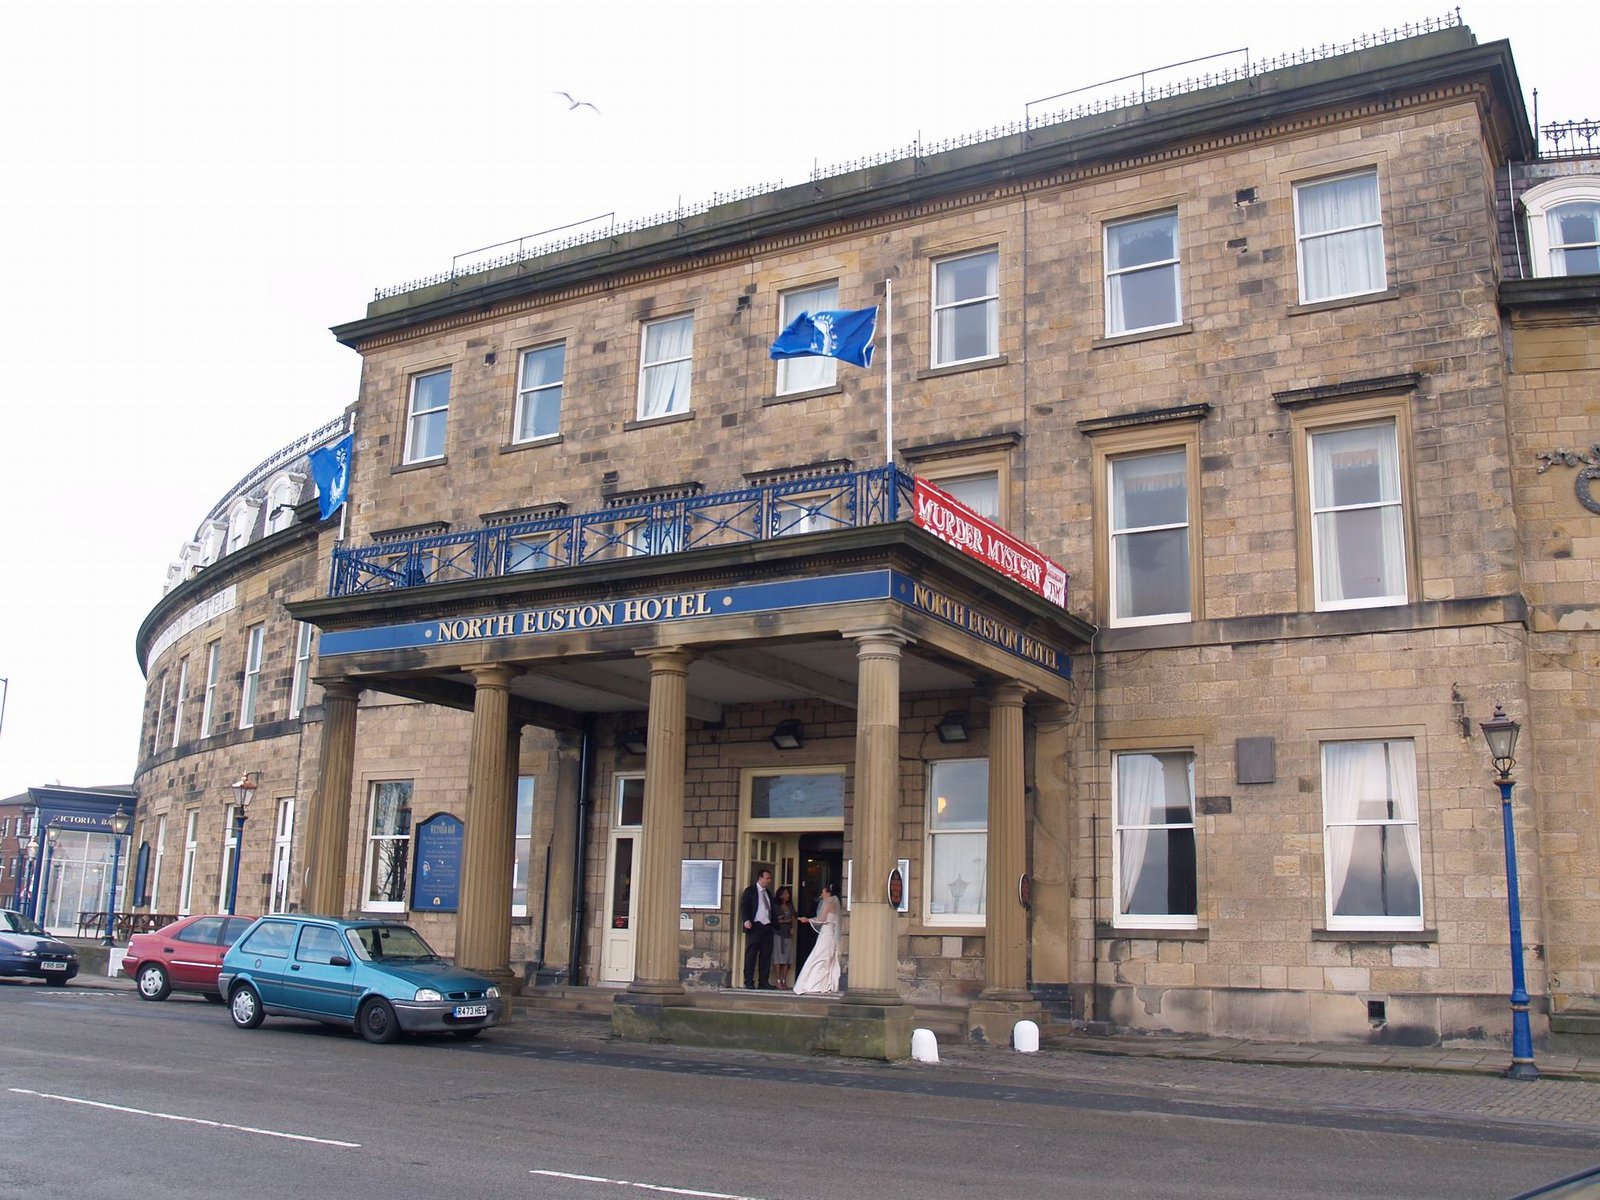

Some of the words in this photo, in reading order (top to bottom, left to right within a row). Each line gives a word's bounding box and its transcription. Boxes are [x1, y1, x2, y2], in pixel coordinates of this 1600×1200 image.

[918, 493, 984, 555] MURDER
[987, 534, 1042, 588] MYSTERY
[437, 615, 515, 642] NORTH
[521, 604, 616, 633] EUSTON
[623, 593, 711, 623] HOTEL
[912, 582, 965, 627] NORTH
[968, 608, 1018, 652] EUSTON
[1020, 636, 1059, 671] HOTEL
[101, 818, 112, 826] BA
[457, 1007, 473, 1015] R473
